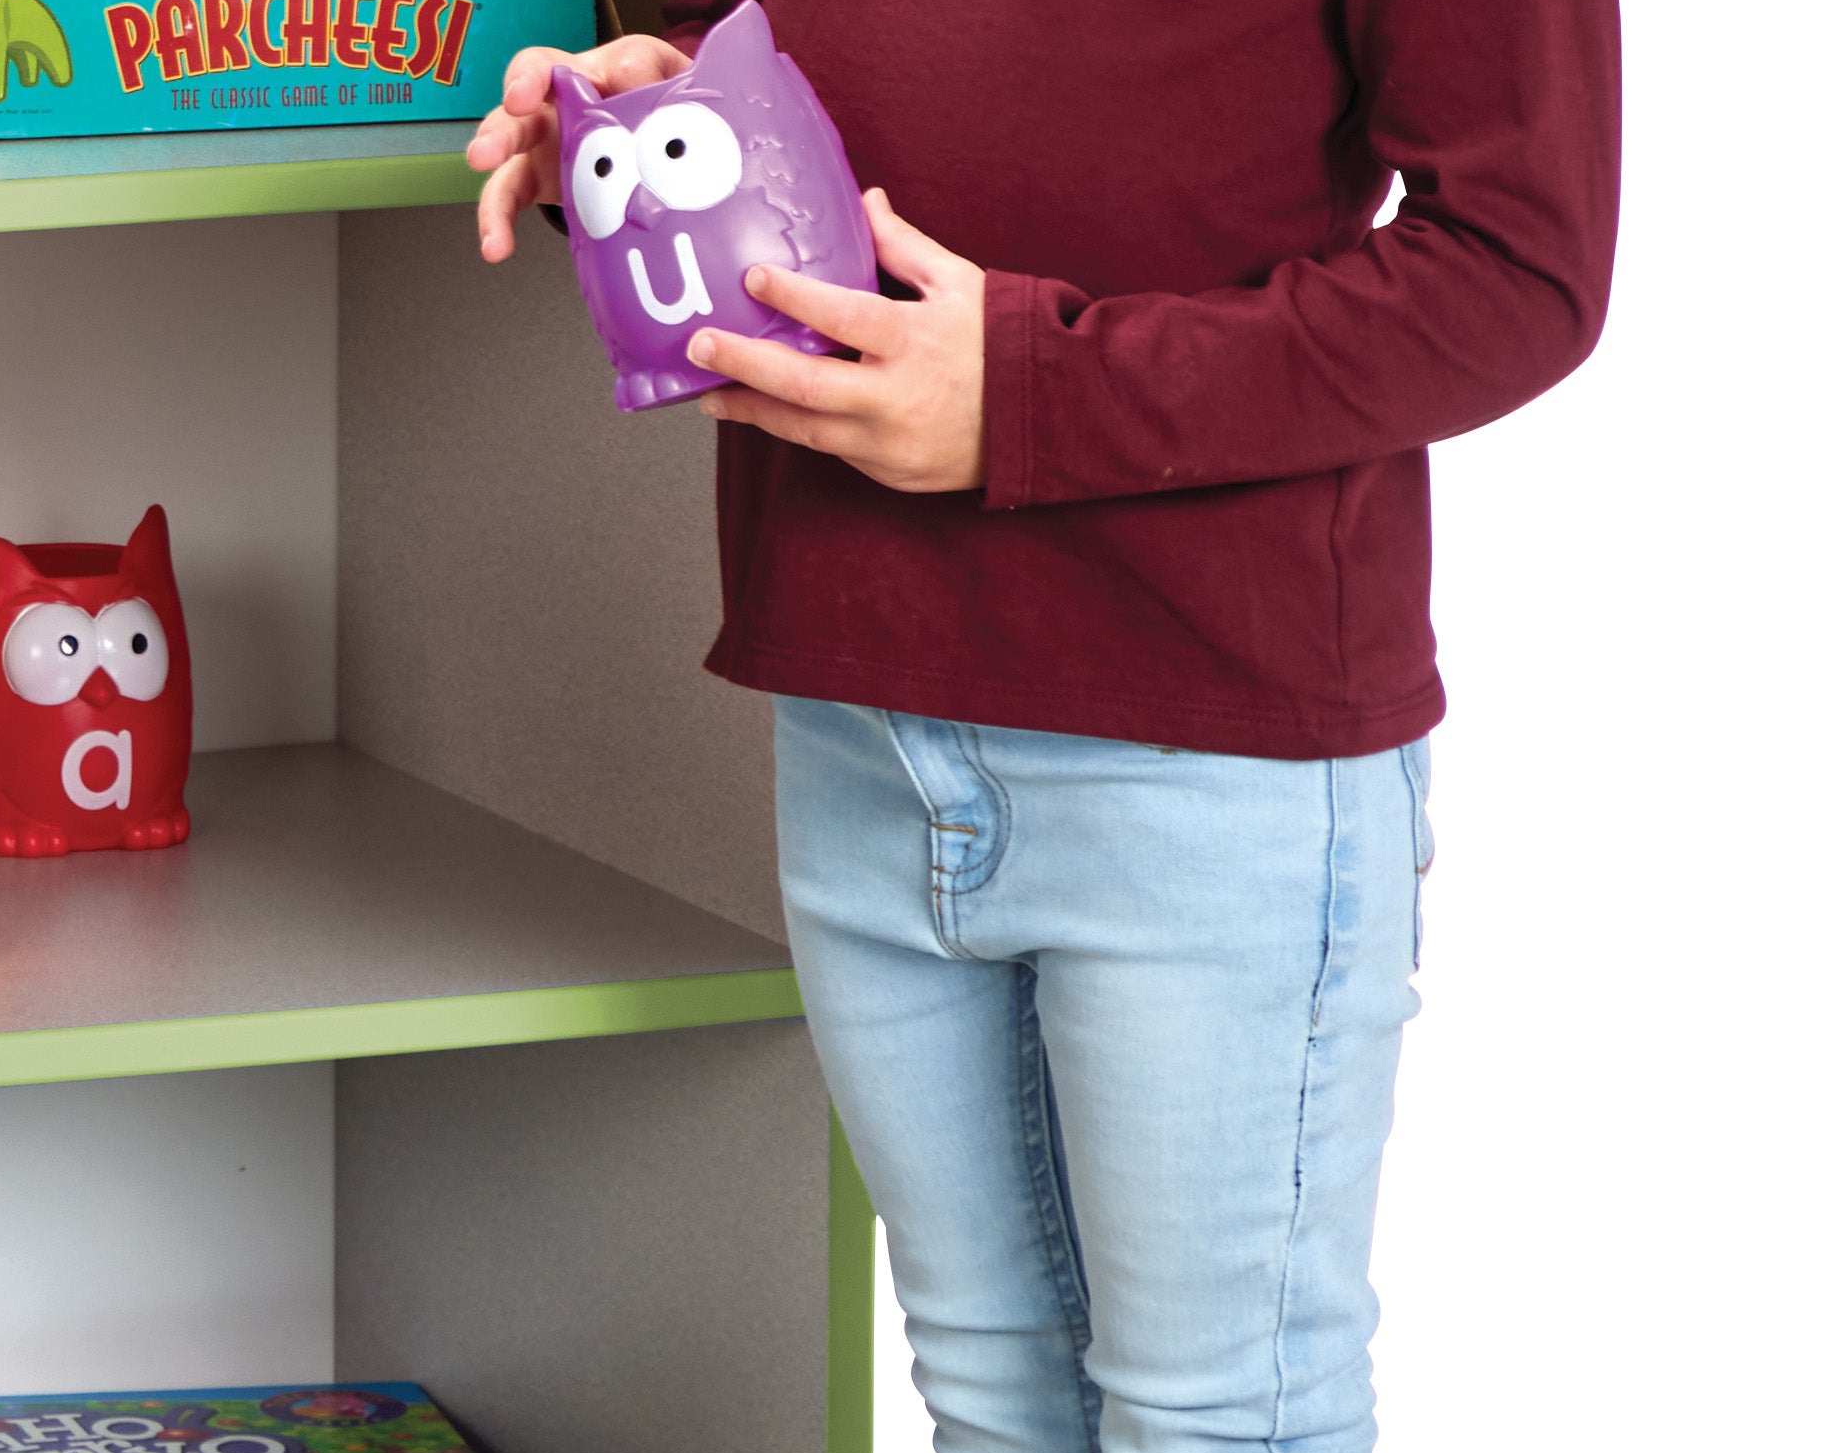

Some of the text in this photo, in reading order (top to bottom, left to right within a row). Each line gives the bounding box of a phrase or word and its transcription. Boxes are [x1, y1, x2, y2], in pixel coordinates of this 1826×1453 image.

[171, 82, 413, 111] THE CLASSIC GAME OF INDIA
[628, 232, 713, 325] u
[61, 729, 132, 812] a
